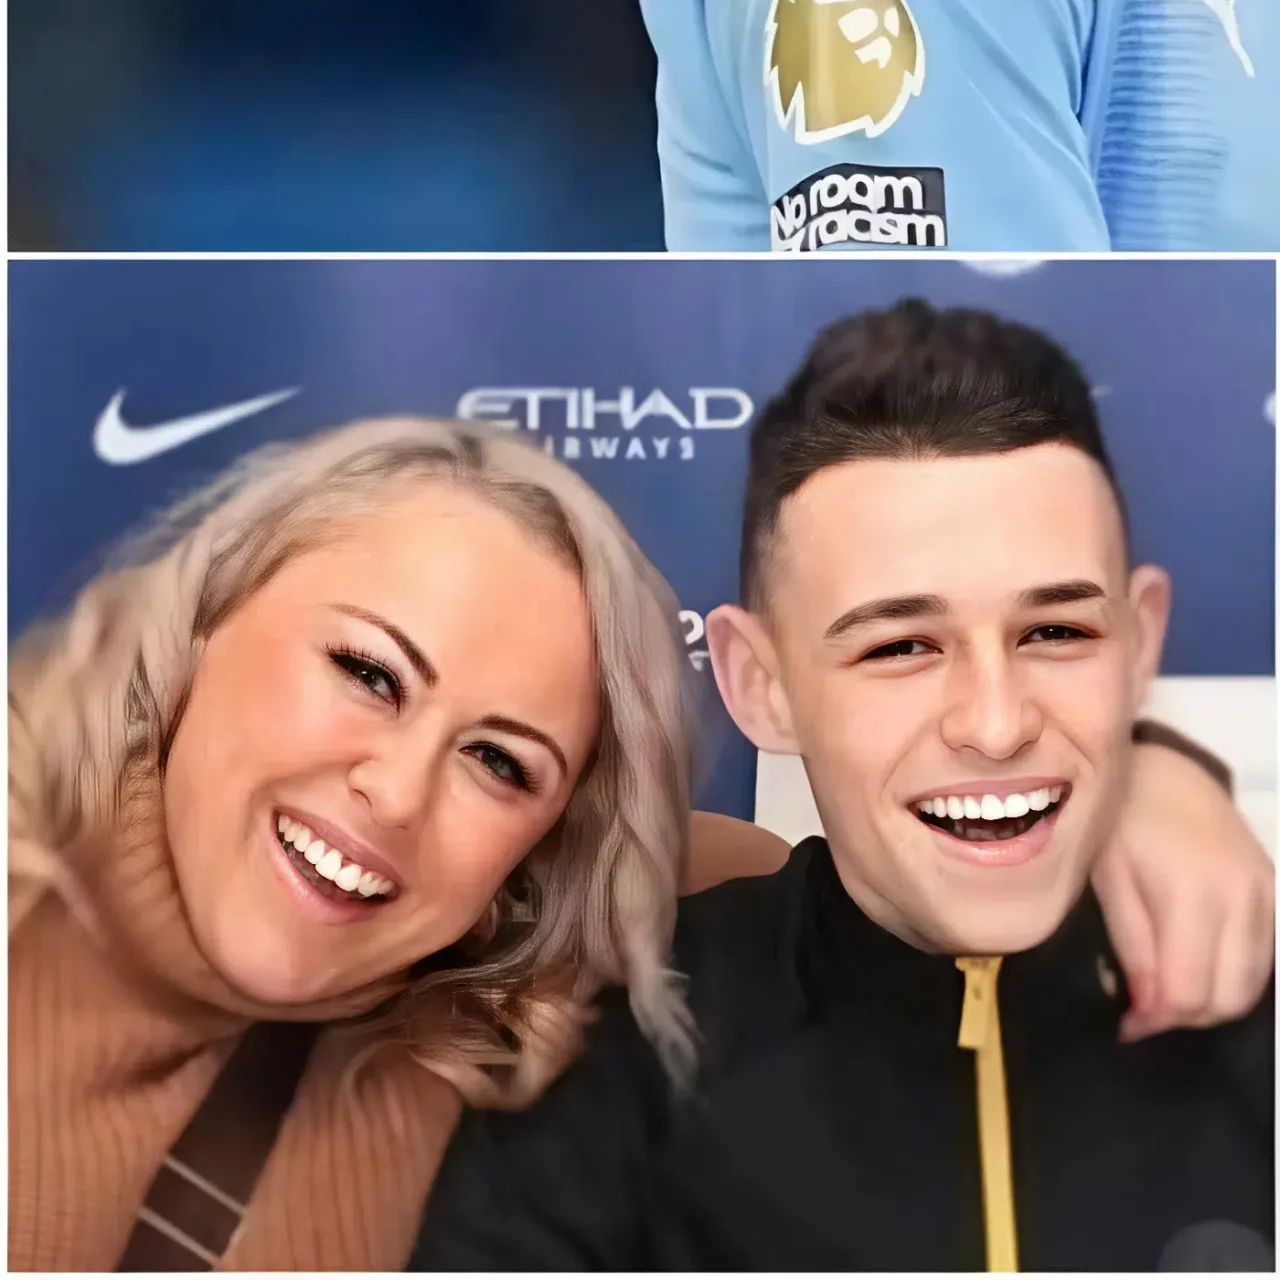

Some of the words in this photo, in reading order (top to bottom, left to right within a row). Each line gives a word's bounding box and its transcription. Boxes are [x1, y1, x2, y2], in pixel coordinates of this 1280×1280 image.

[770, 193, 807, 241] No
[809, 173, 924, 216] room
[457, 386, 755, 430] ETIHAD
